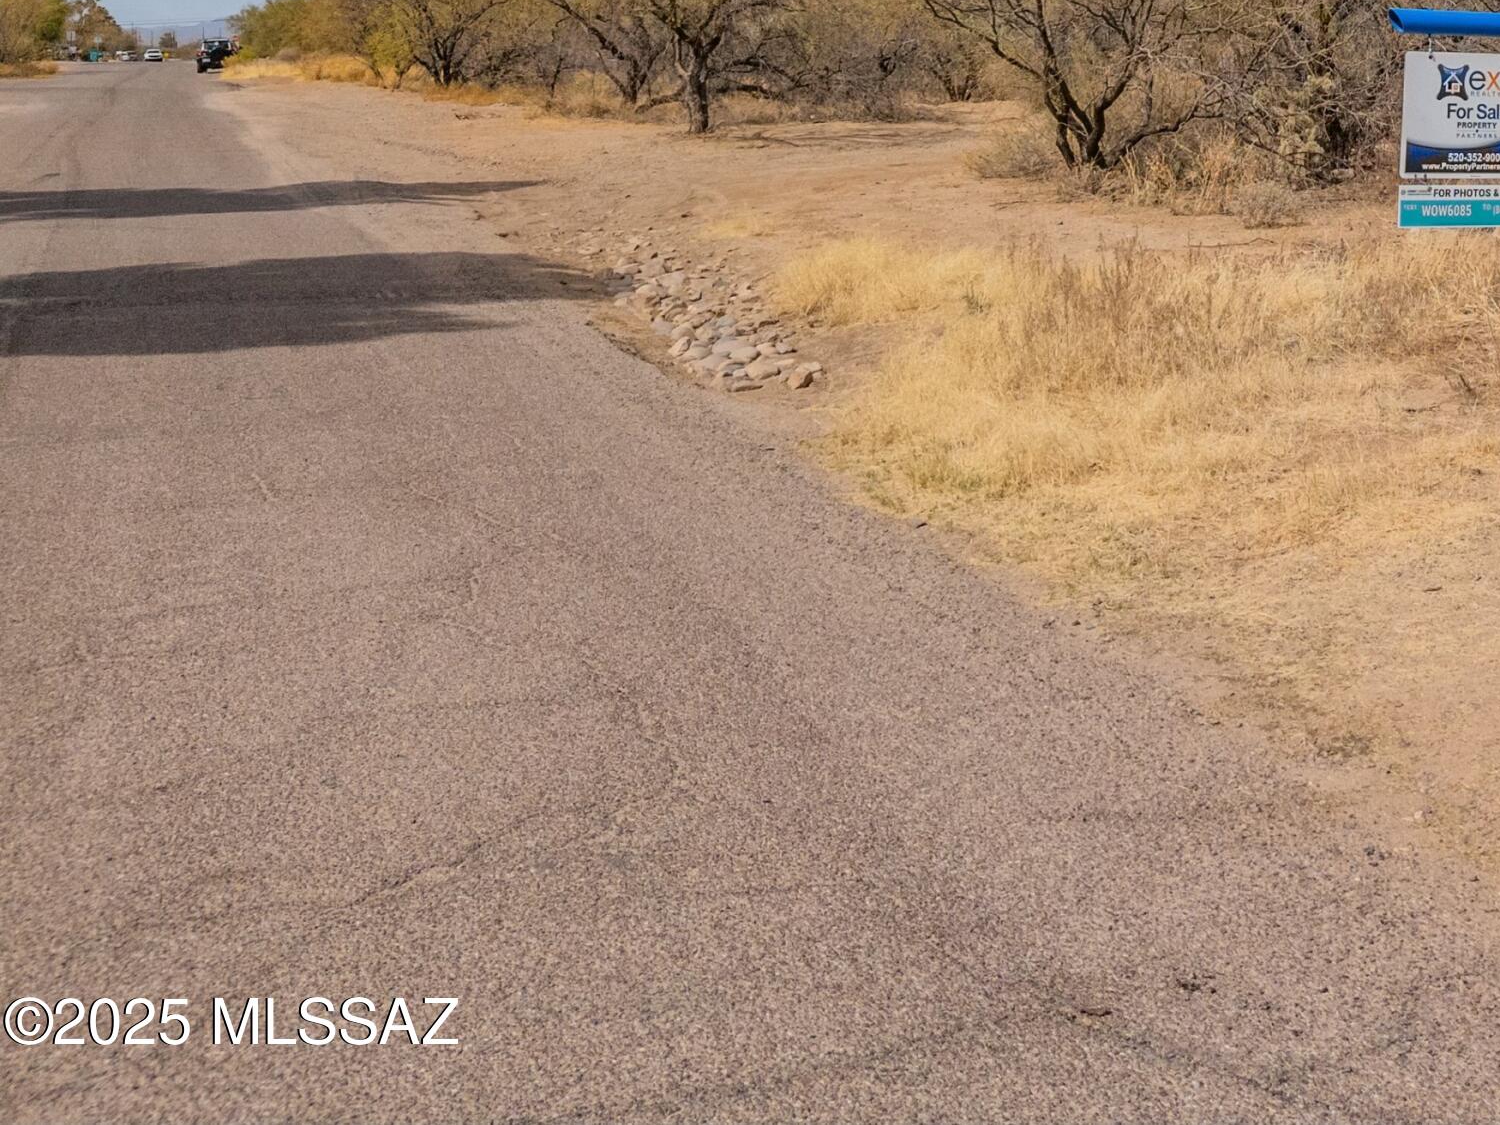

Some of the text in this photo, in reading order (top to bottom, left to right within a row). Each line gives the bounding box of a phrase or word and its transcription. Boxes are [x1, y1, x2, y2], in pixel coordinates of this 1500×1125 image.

[1447, 103, 1474, 119] For
[1456, 121, 1498, 129] PROPERTY
[1433, 188, 1452, 198] FOR
[1453, 188, 1492, 197] PHOTOS
[1493, 188, 1500, 197] &
[1421, 204, 1472, 217] WOW6085
